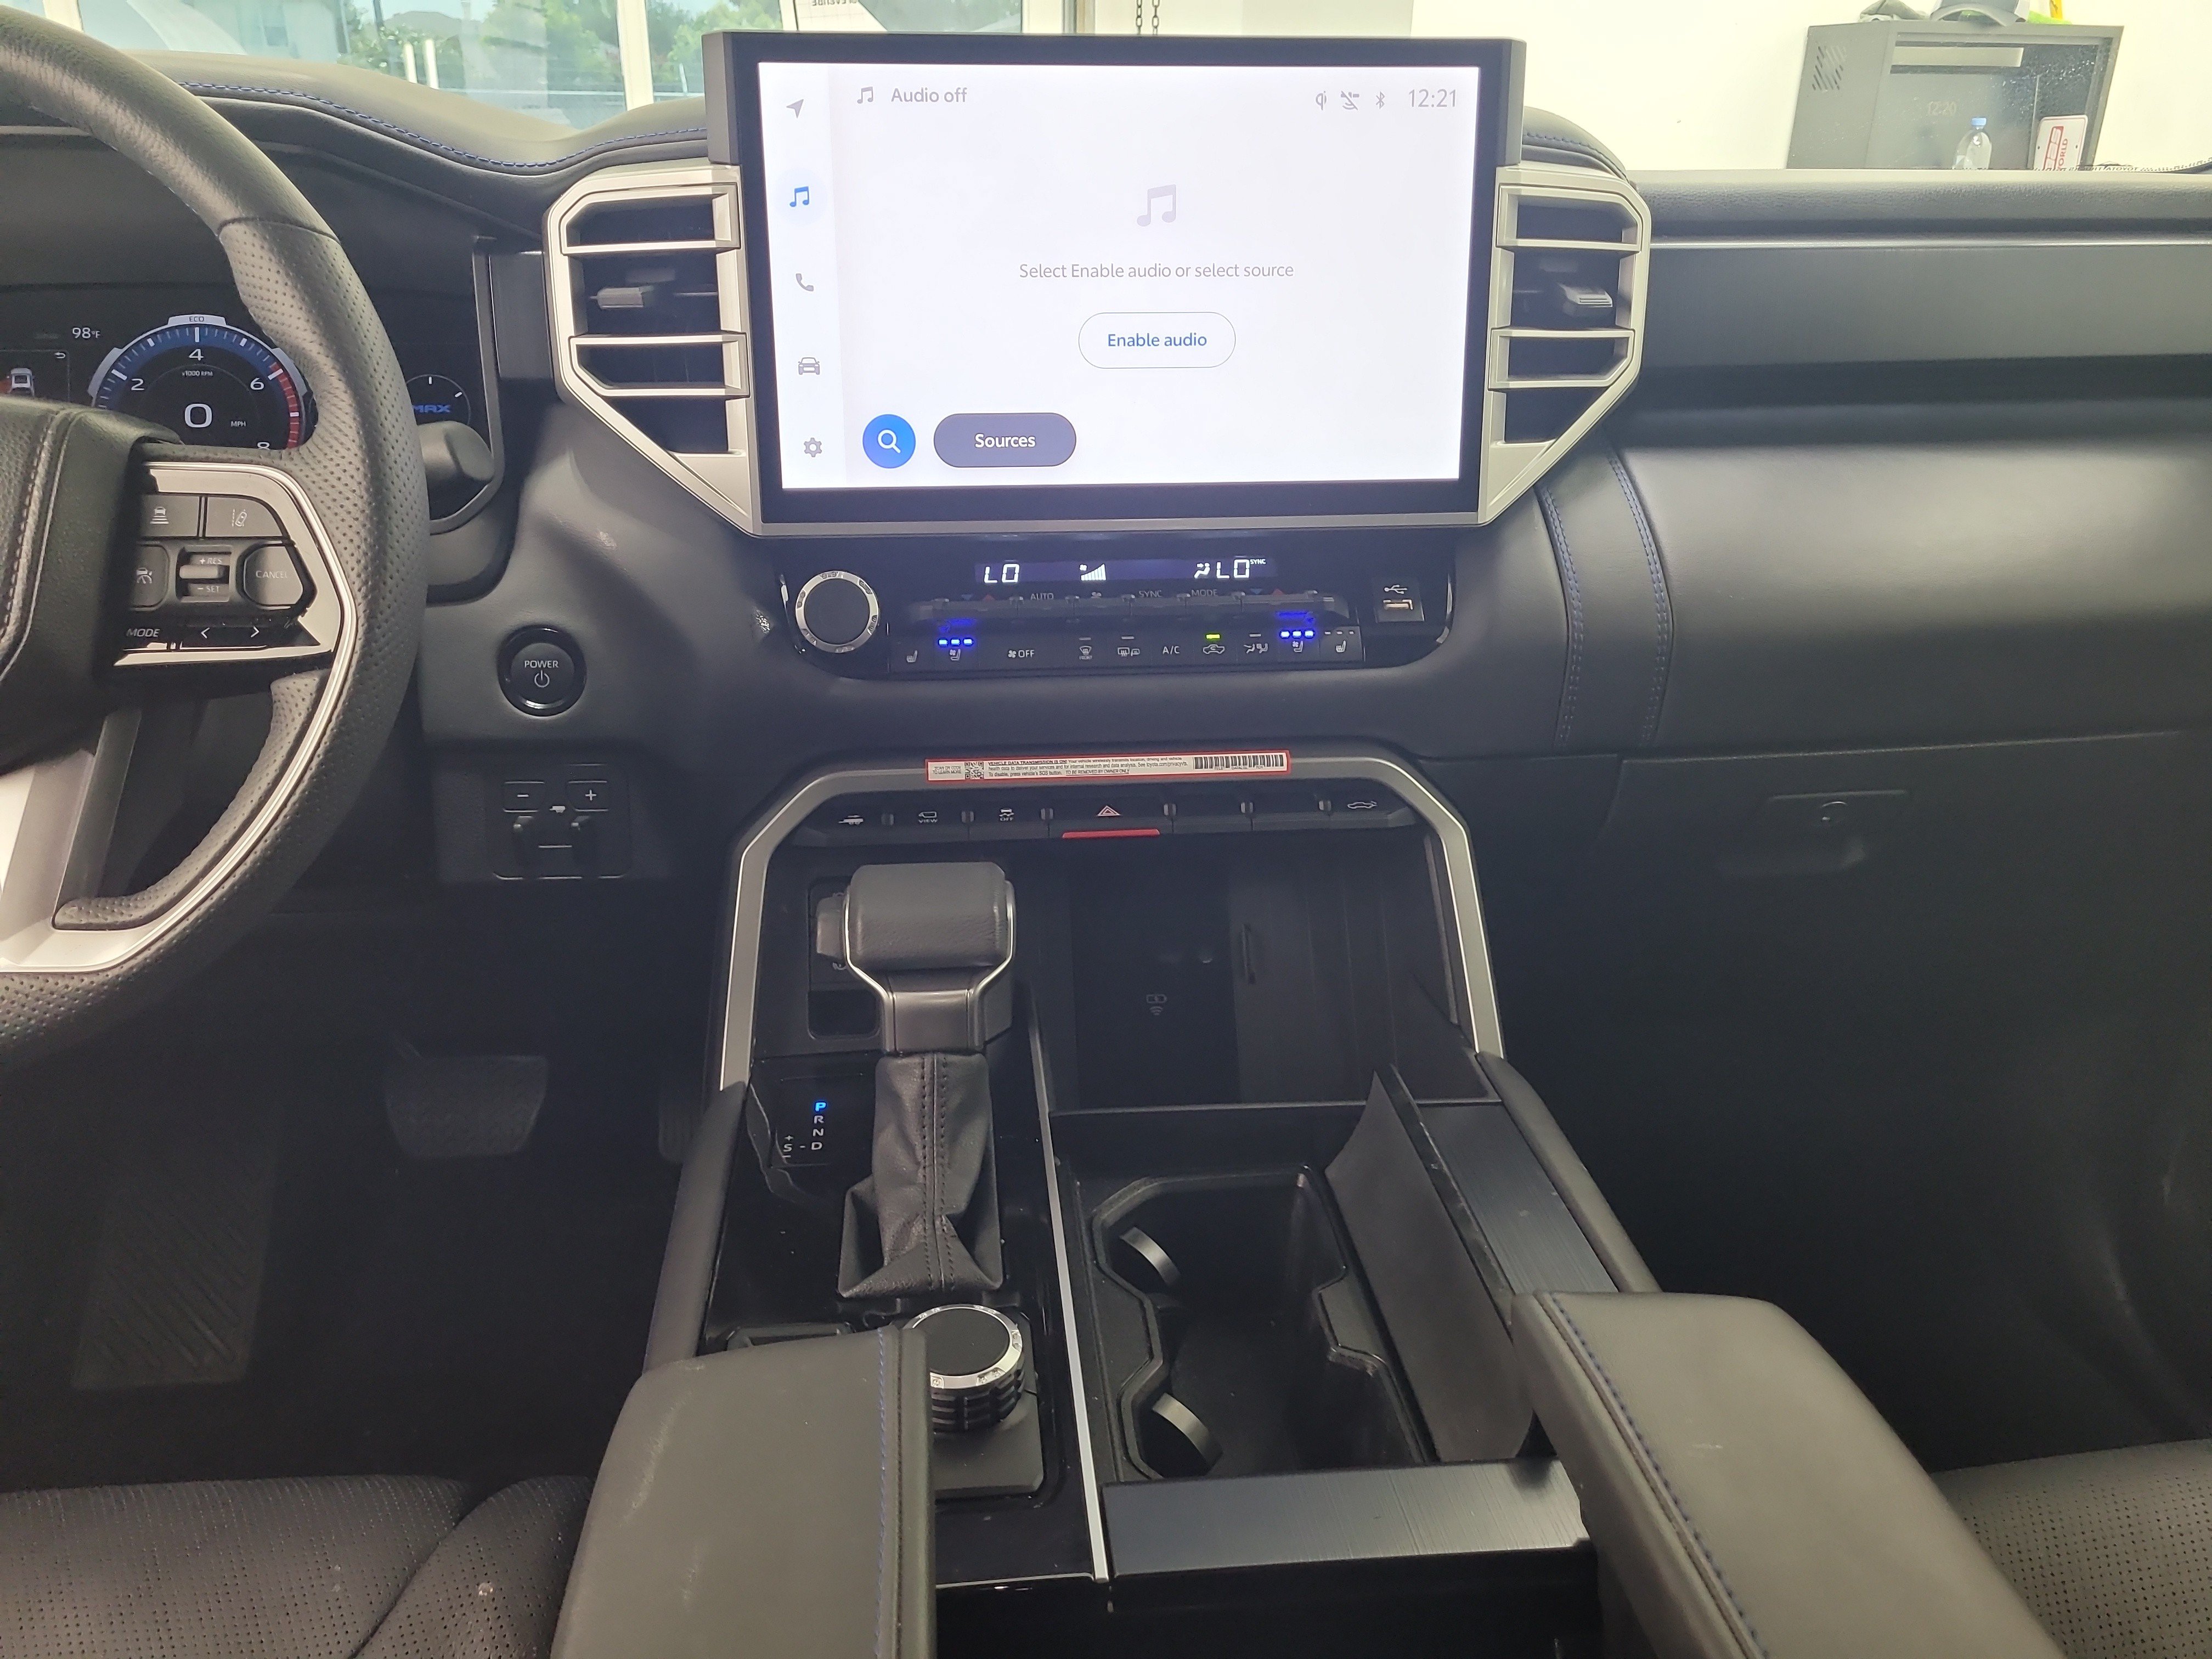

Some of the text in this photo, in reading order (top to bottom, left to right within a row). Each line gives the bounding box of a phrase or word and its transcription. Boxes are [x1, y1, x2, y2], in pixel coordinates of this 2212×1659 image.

[891, 87, 968, 103] Audio off
[1408, 89, 1457, 108] 12:21
[1019, 263, 1294, 278] Select Enable audio or select source
[1108, 332, 1207, 348] Enable audio
[189, 348, 204, 361] 4
[131, 378, 145, 391] 2
[250, 377, 264, 390] 6
[184, 403, 212, 428] 0
[974, 433, 1036, 449] Sources
[126, 628, 161, 637] MODE
[1018, 649, 1035, 658] OFF
[1162, 645, 1180, 654] A/C
[524, 660, 559, 668] POWER
[815, 1102, 827, 1112] P
[814, 1115, 824, 1124] R
[812, 1128, 824, 1137] N
[783, 1143, 793, 1152] S
[811, 1142, 823, 1150] D
